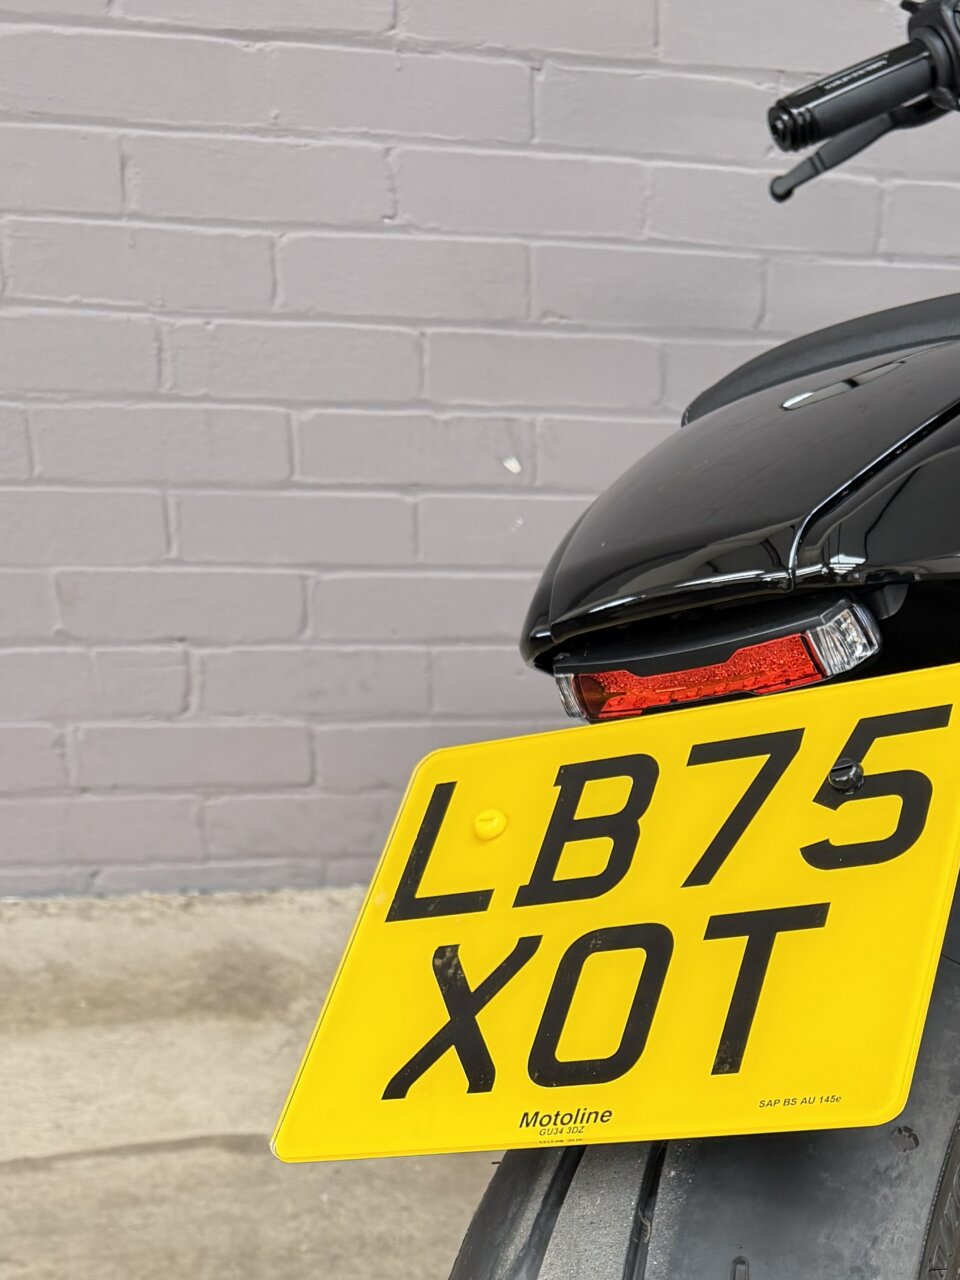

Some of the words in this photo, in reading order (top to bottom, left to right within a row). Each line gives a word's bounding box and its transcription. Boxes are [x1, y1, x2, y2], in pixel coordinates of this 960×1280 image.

[385, 704, 953, 922] LB75
[382, 903, 830, 1100] XOT
[759, 1098, 780, 1108] SAP
[783, 1097, 797, 1106] BS
[800, 1096, 816, 1105] AU
[819, 1094, 841, 1103] 145e
[519, 1107, 613, 1128] Motoline
[539, 1128, 564, 1136] GU34
[566, 1126, 586, 1134] 3DZ
